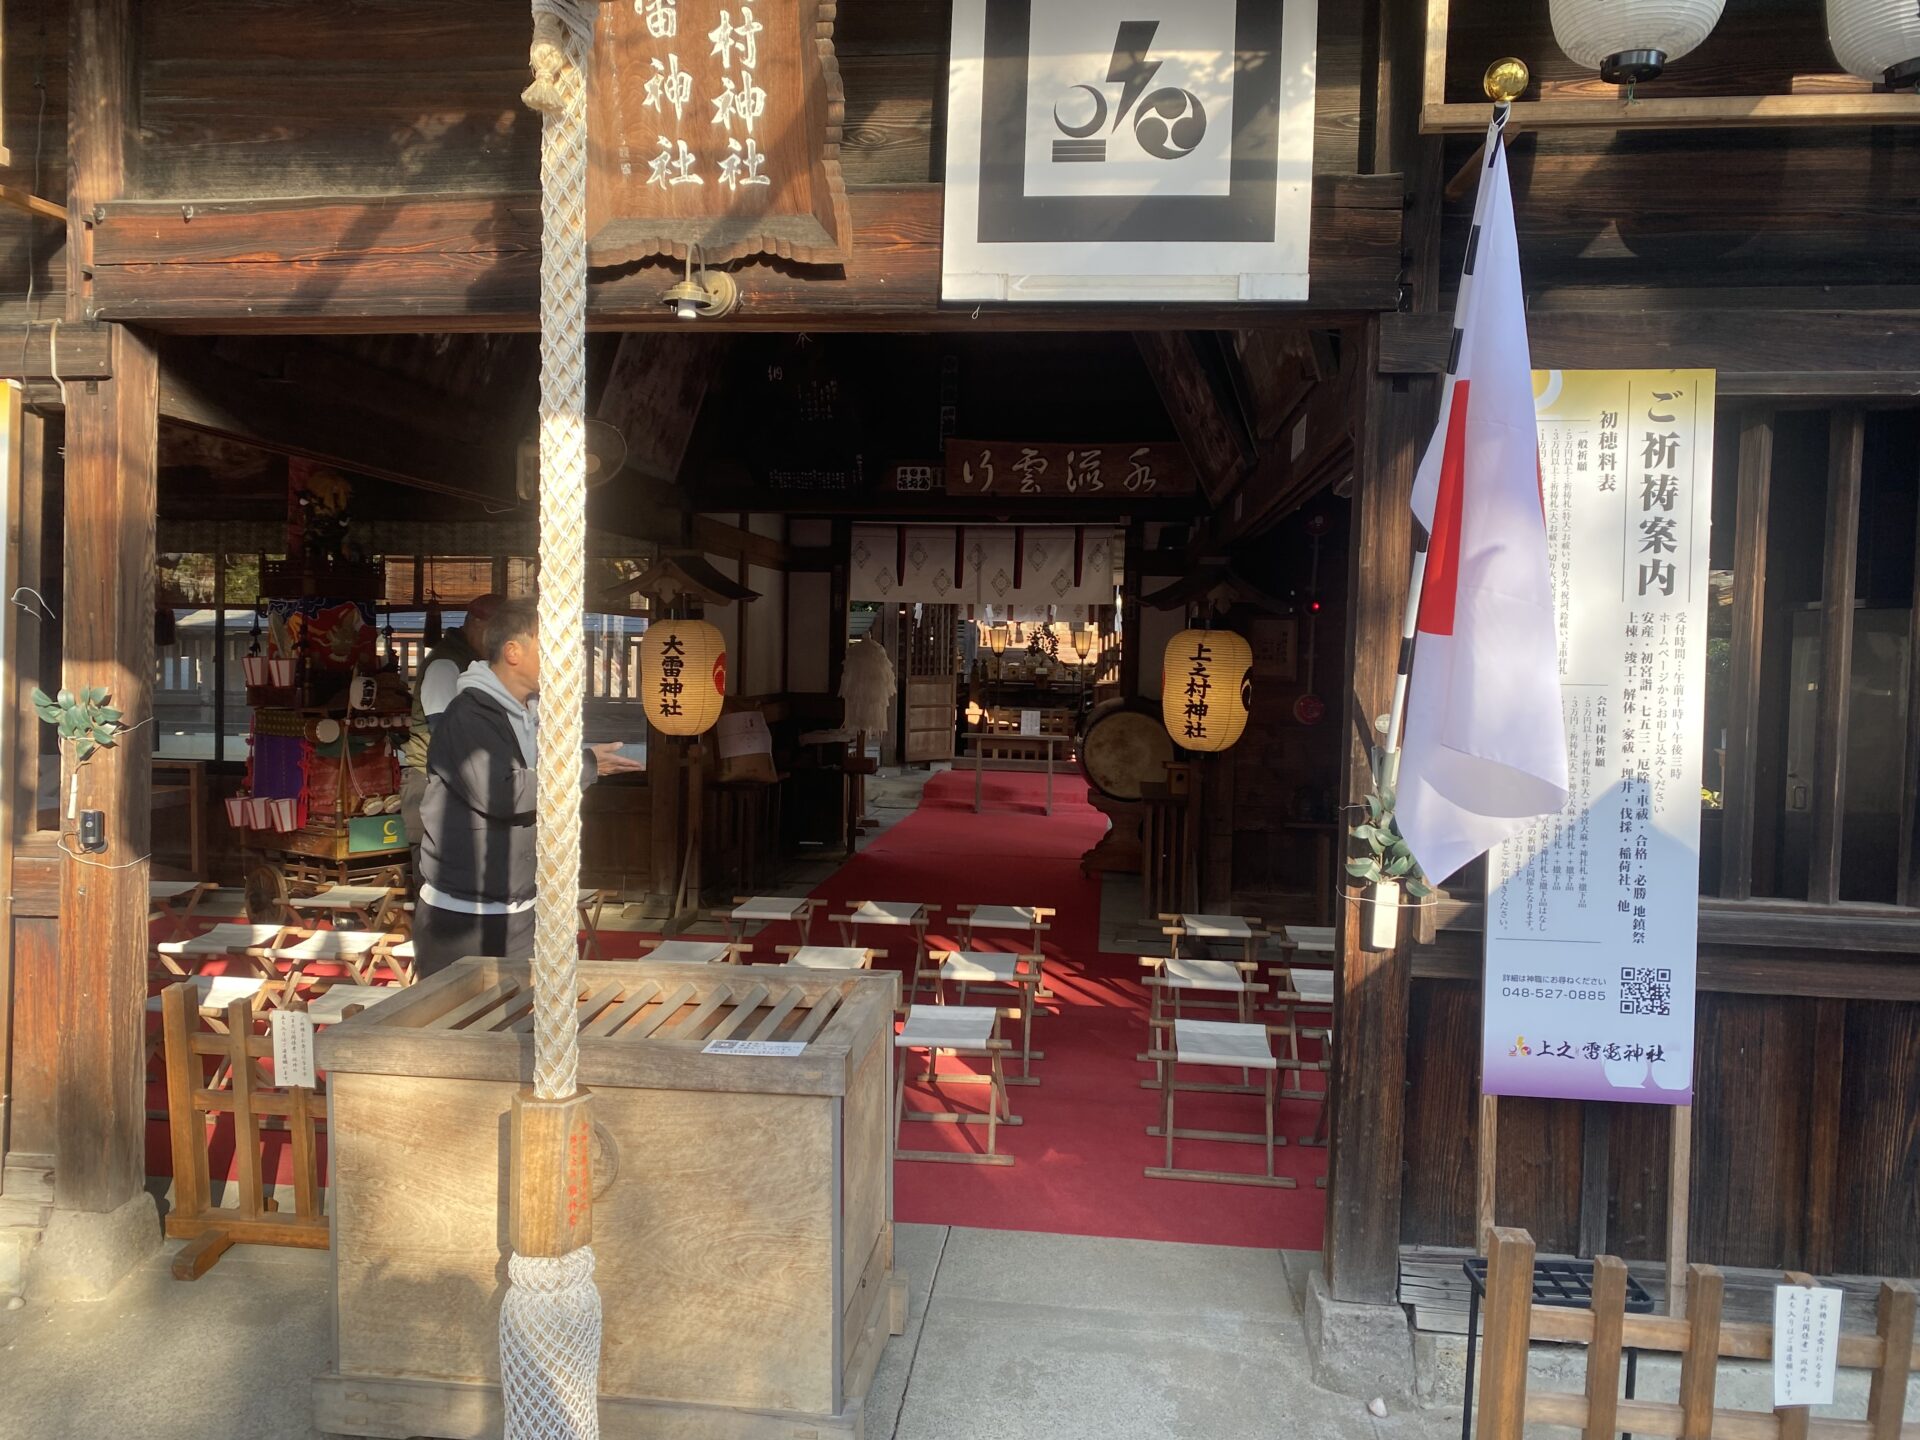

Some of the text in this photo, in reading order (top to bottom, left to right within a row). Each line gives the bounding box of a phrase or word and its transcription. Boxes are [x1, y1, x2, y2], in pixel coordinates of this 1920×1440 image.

[1576, 430, 1589, 472] 一般祈願
[1597, 409, 1618, 493] 初穂料表
[1638, 390, 1684, 597] ご祈祷案内
[659, 635, 685, 717] 大雷神社
[1182, 643, 1212, 739] 上之村神社
[1653, 612, 1671, 814] ホームページからお申し込みください
[1594, 696, 1608, 768] 会社・団体祈願
[1502, 974, 1607, 986] 詳細は神職にお尋ねください
[1502, 987, 1606, 1001] 048-527-0885
